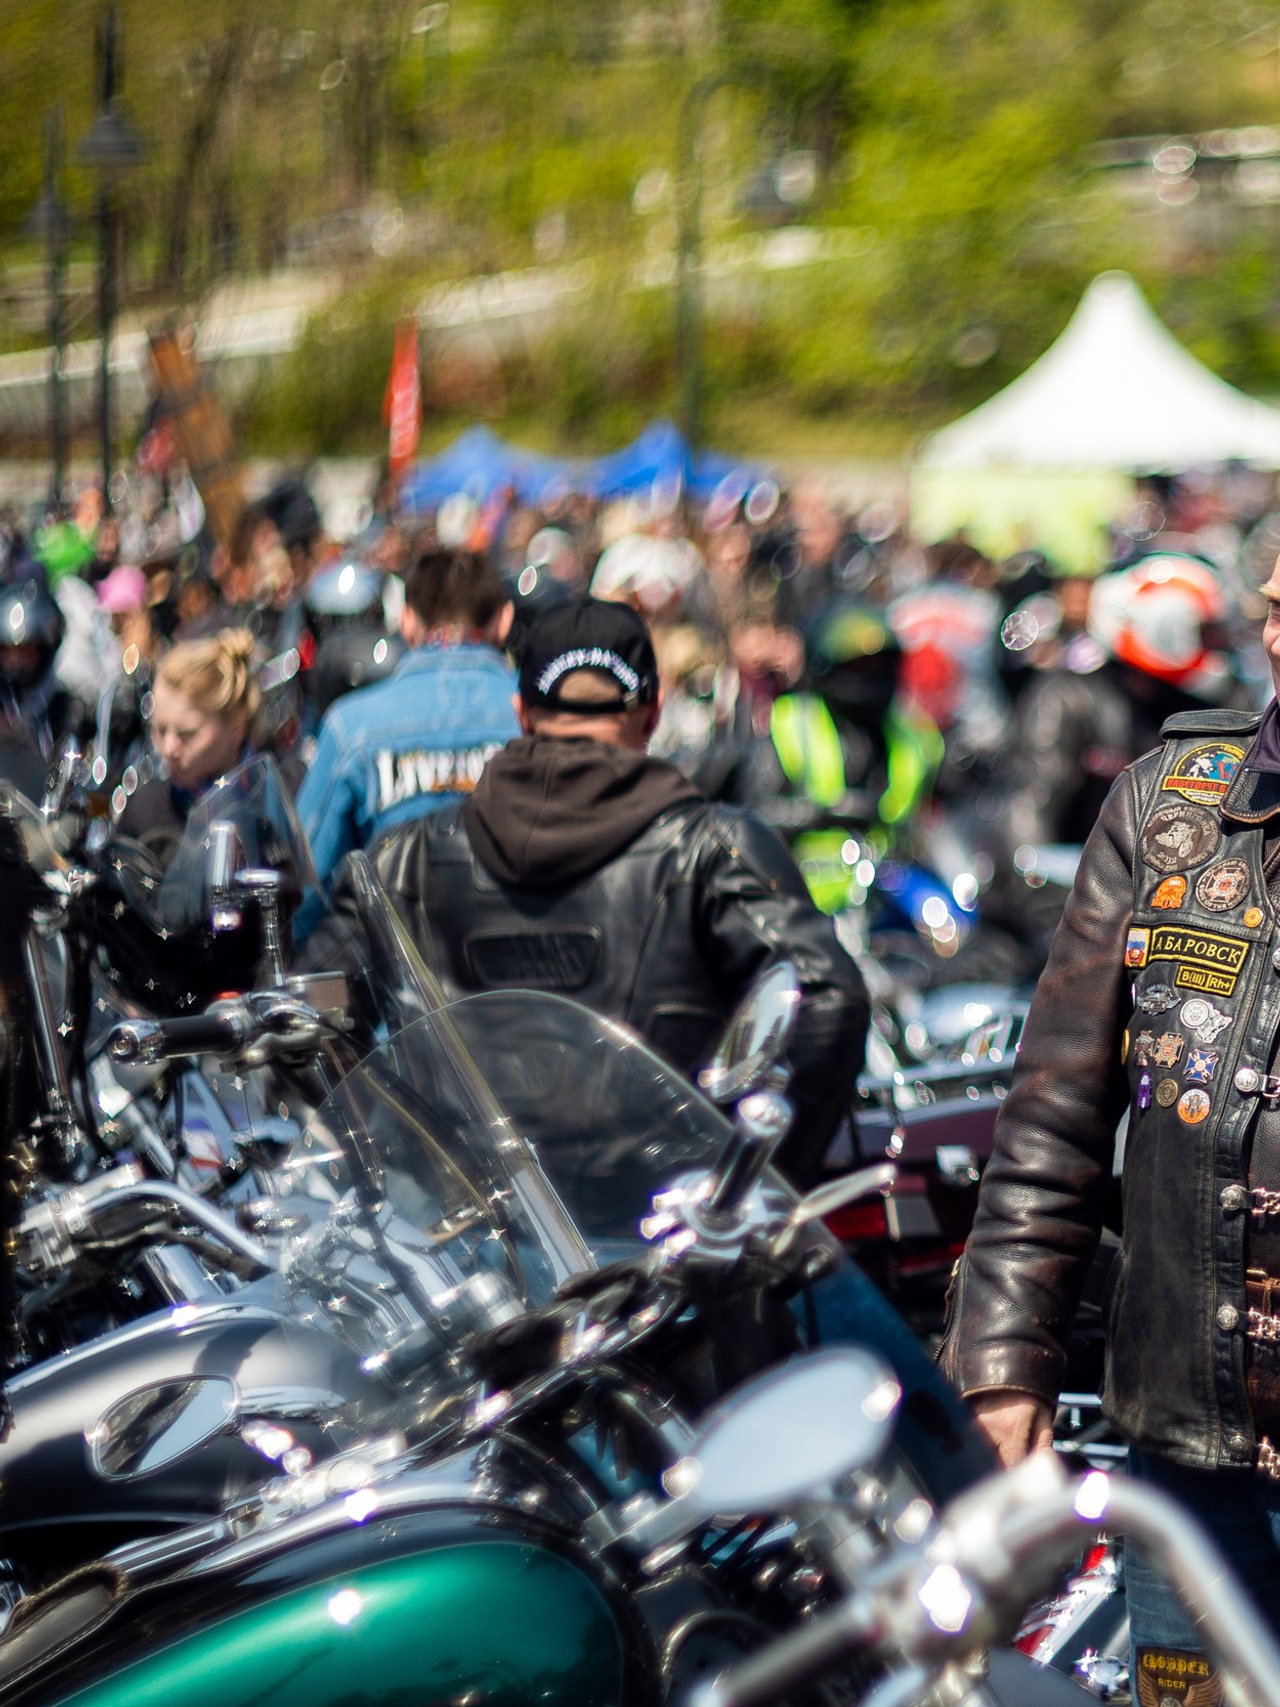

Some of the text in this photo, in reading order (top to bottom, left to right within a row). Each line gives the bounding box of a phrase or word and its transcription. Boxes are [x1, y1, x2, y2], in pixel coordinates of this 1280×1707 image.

[1154, 935, 1242, 964] АБАРОВСК
[1143, 1654, 1209, 1676] CHOPPER
[1157, 1678, 1185, 1689] RIDER
